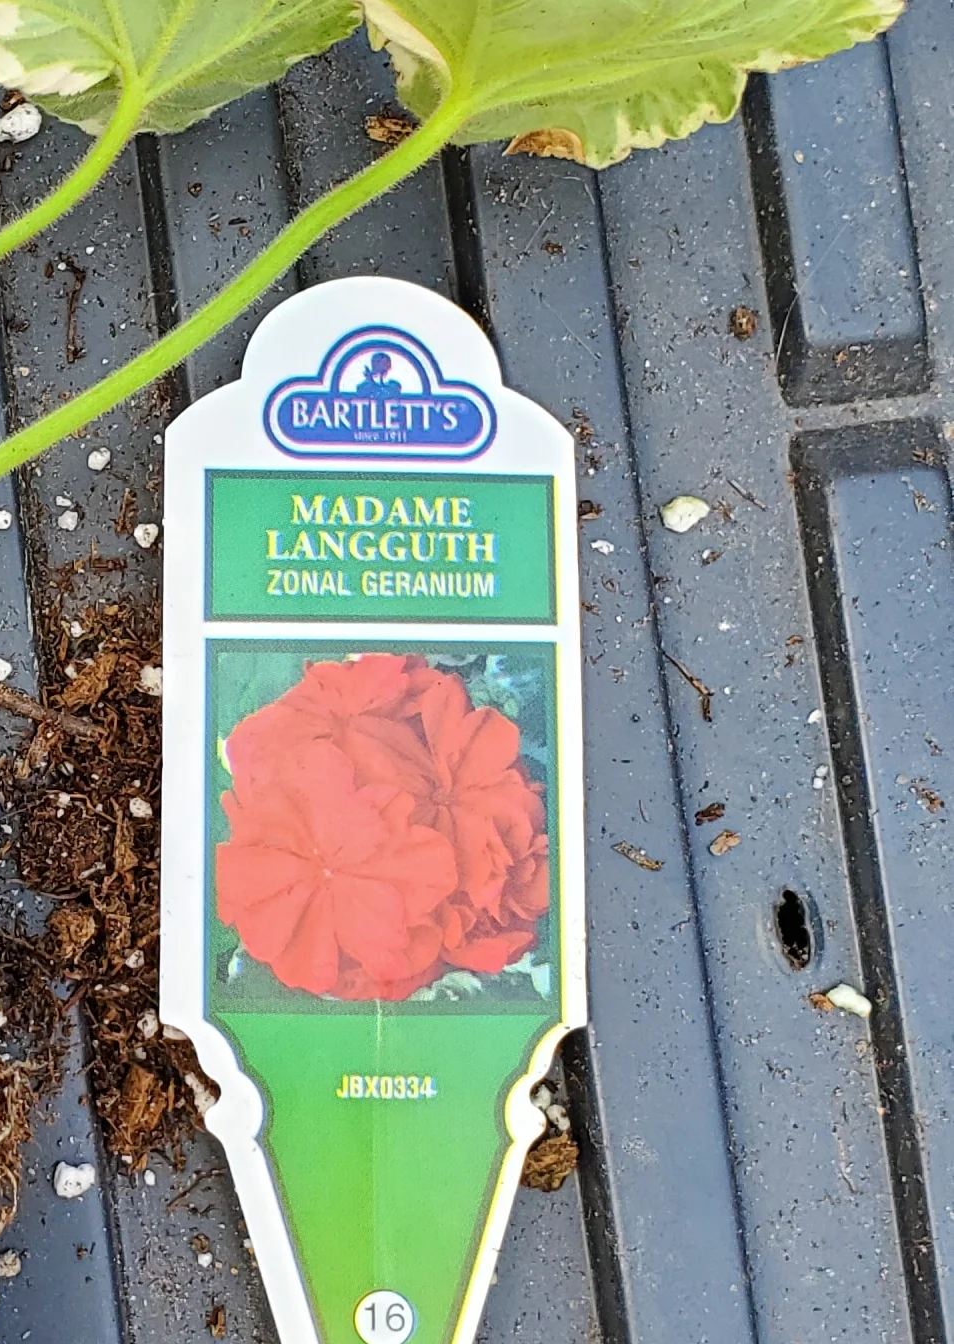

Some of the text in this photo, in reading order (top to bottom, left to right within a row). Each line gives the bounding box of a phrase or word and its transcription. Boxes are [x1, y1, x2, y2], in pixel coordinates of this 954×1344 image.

[292, 399, 458, 430] BARTLETT'S
[291, 495, 473, 527] MADAME
[266, 529, 497, 563] LANGGUTH
[266, 569, 496, 598] ZONAL GERANIUM
[336, 1074, 437, 1099] JBX0334
[364, 1302, 405, 1332] 16
